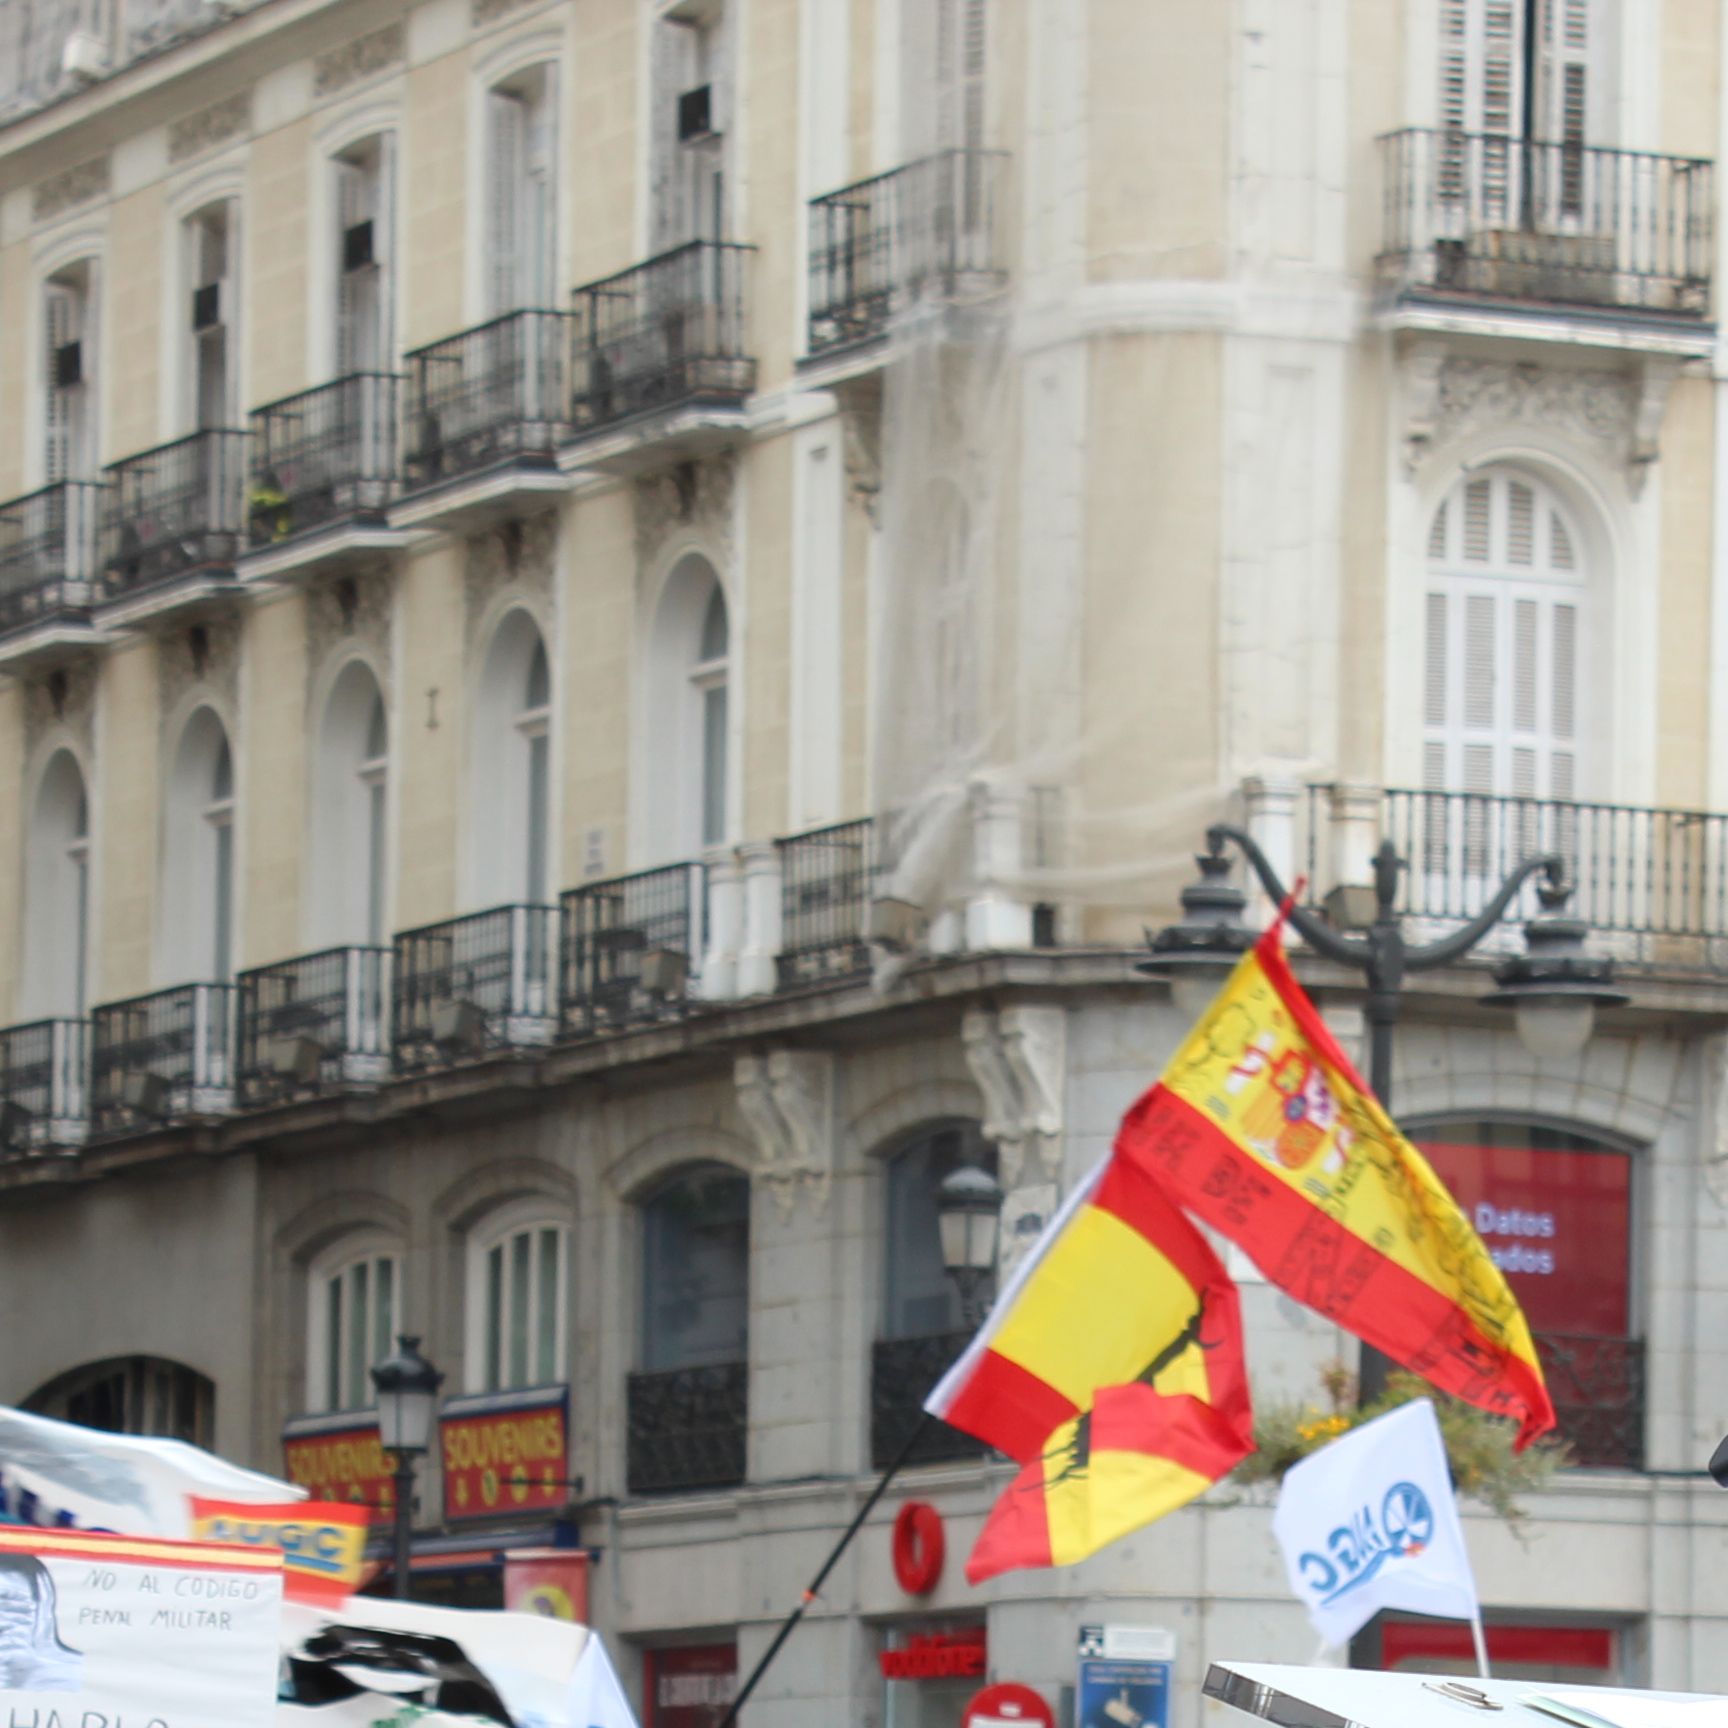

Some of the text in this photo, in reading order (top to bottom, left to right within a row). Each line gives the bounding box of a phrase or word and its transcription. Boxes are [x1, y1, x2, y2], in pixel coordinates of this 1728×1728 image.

[1475, 1207, 1555, 1237] Datos
[445, 1415, 563, 1471] SOUVENIRS
[80, 1568, 259, 1601] NO AL CODIGO
[150, 1608, 234, 1632] MILITAR
